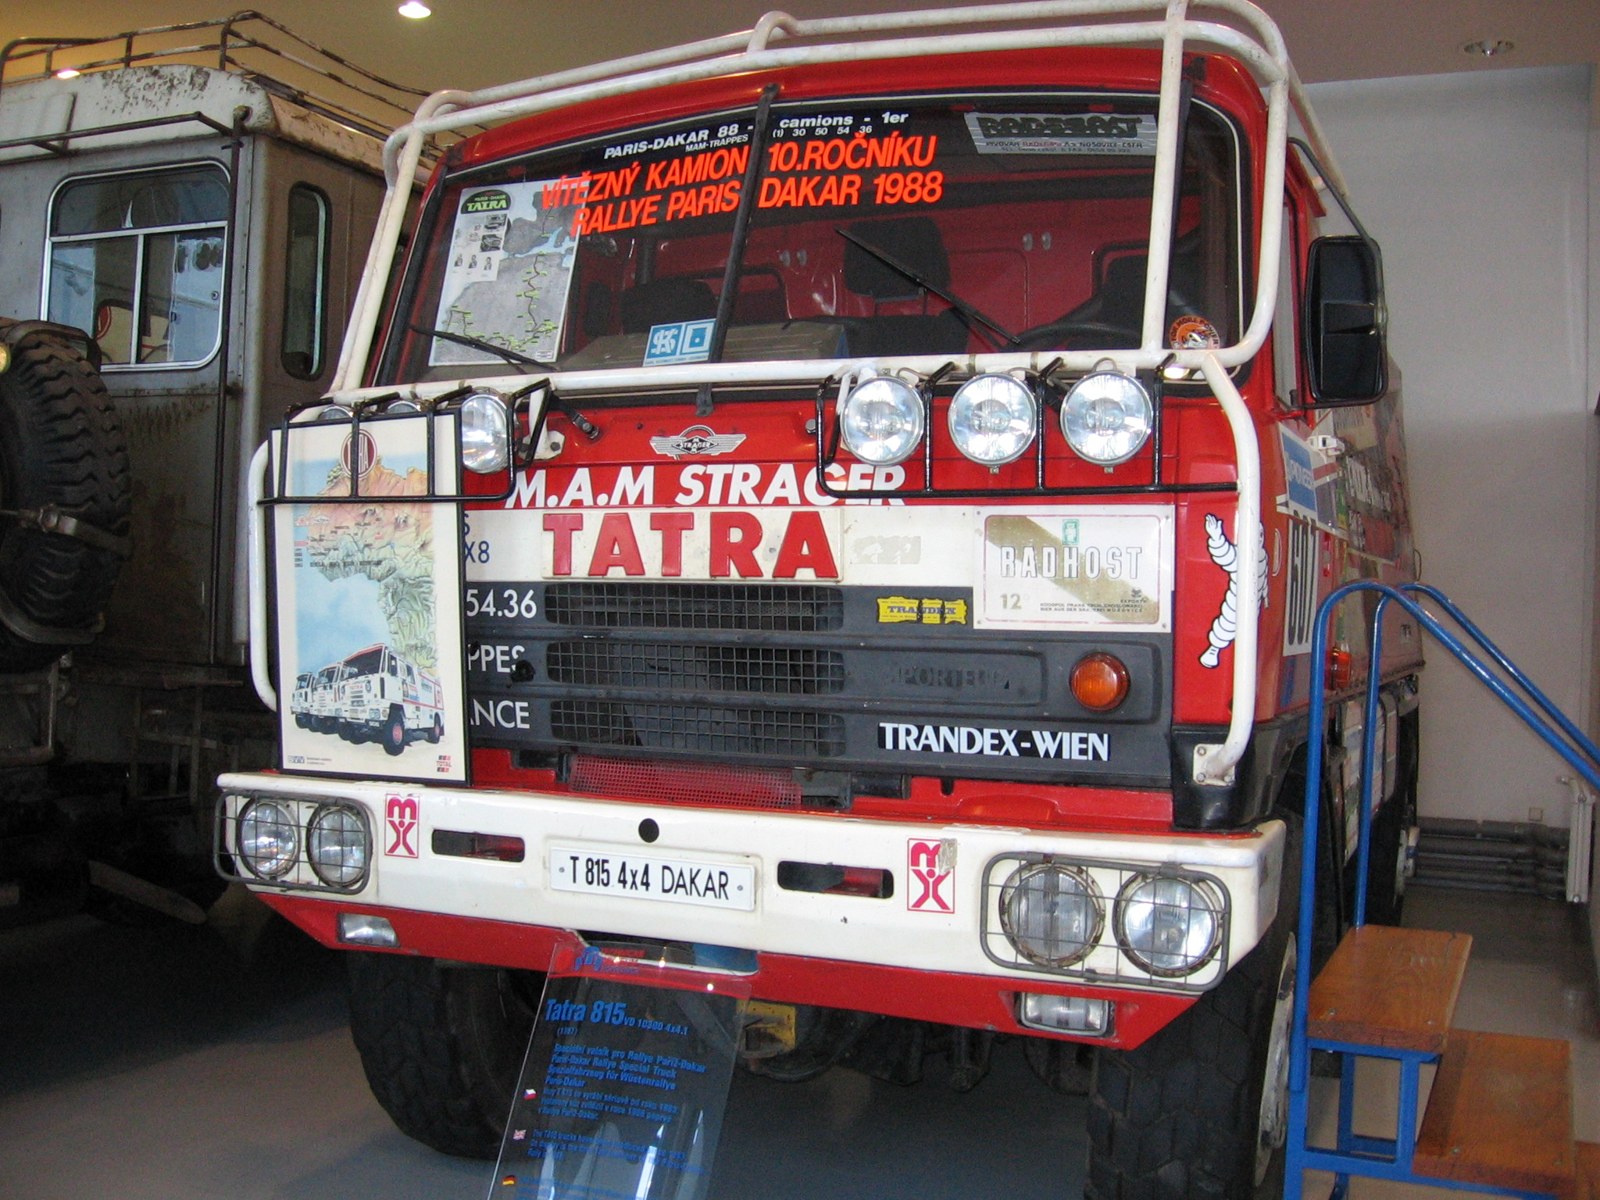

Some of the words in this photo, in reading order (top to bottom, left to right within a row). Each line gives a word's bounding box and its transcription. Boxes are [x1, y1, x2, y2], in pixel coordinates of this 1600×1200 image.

[604, 129, 709, 159] PARIS-DAKAR
[718, 124, 739, 138] 88
[779, 114, 854, 129] camions
[882, 111, 909, 124] 1er
[685, 134, 749, 152] MAM-TRAPPES
[792, 128, 806, 137] 30
[815, 127, 828, 136] 50
[837, 126, 850, 135] 54
[859, 125, 873, 134] 36
[542, 161, 642, 210] VÍTĚZNÝ
[645, 145, 749, 191] KAMION
[768, 130, 938, 172] 10.ROČNÍKU
[466, 200, 507, 211] TATRA
[570, 195, 662, 238] RALLYE
[666, 180, 741, 221] PARIS
[758, 174, 861, 208] DAKAR
[873, 171, 944, 205] 1988
[504, 466, 654, 509] M.A.M
[675, 462, 907, 508] STRAGER
[543, 510, 838, 577] TATRA
[1000, 545, 1142, 580] RADHOST
[466, 588, 537, 619] 54.36
[470, 699, 530, 729] NCE
[879, 722, 1109, 762] TRANDEX-WIEN
[570, 856, 580, 884] T
[585, 858, 610, 887] 815
[618, 861, 650, 892] 4x4
[661, 865, 729, 900] DAKAR
[545, 999, 586, 1022] Tatra
[590, 1000, 627, 1025] 815
